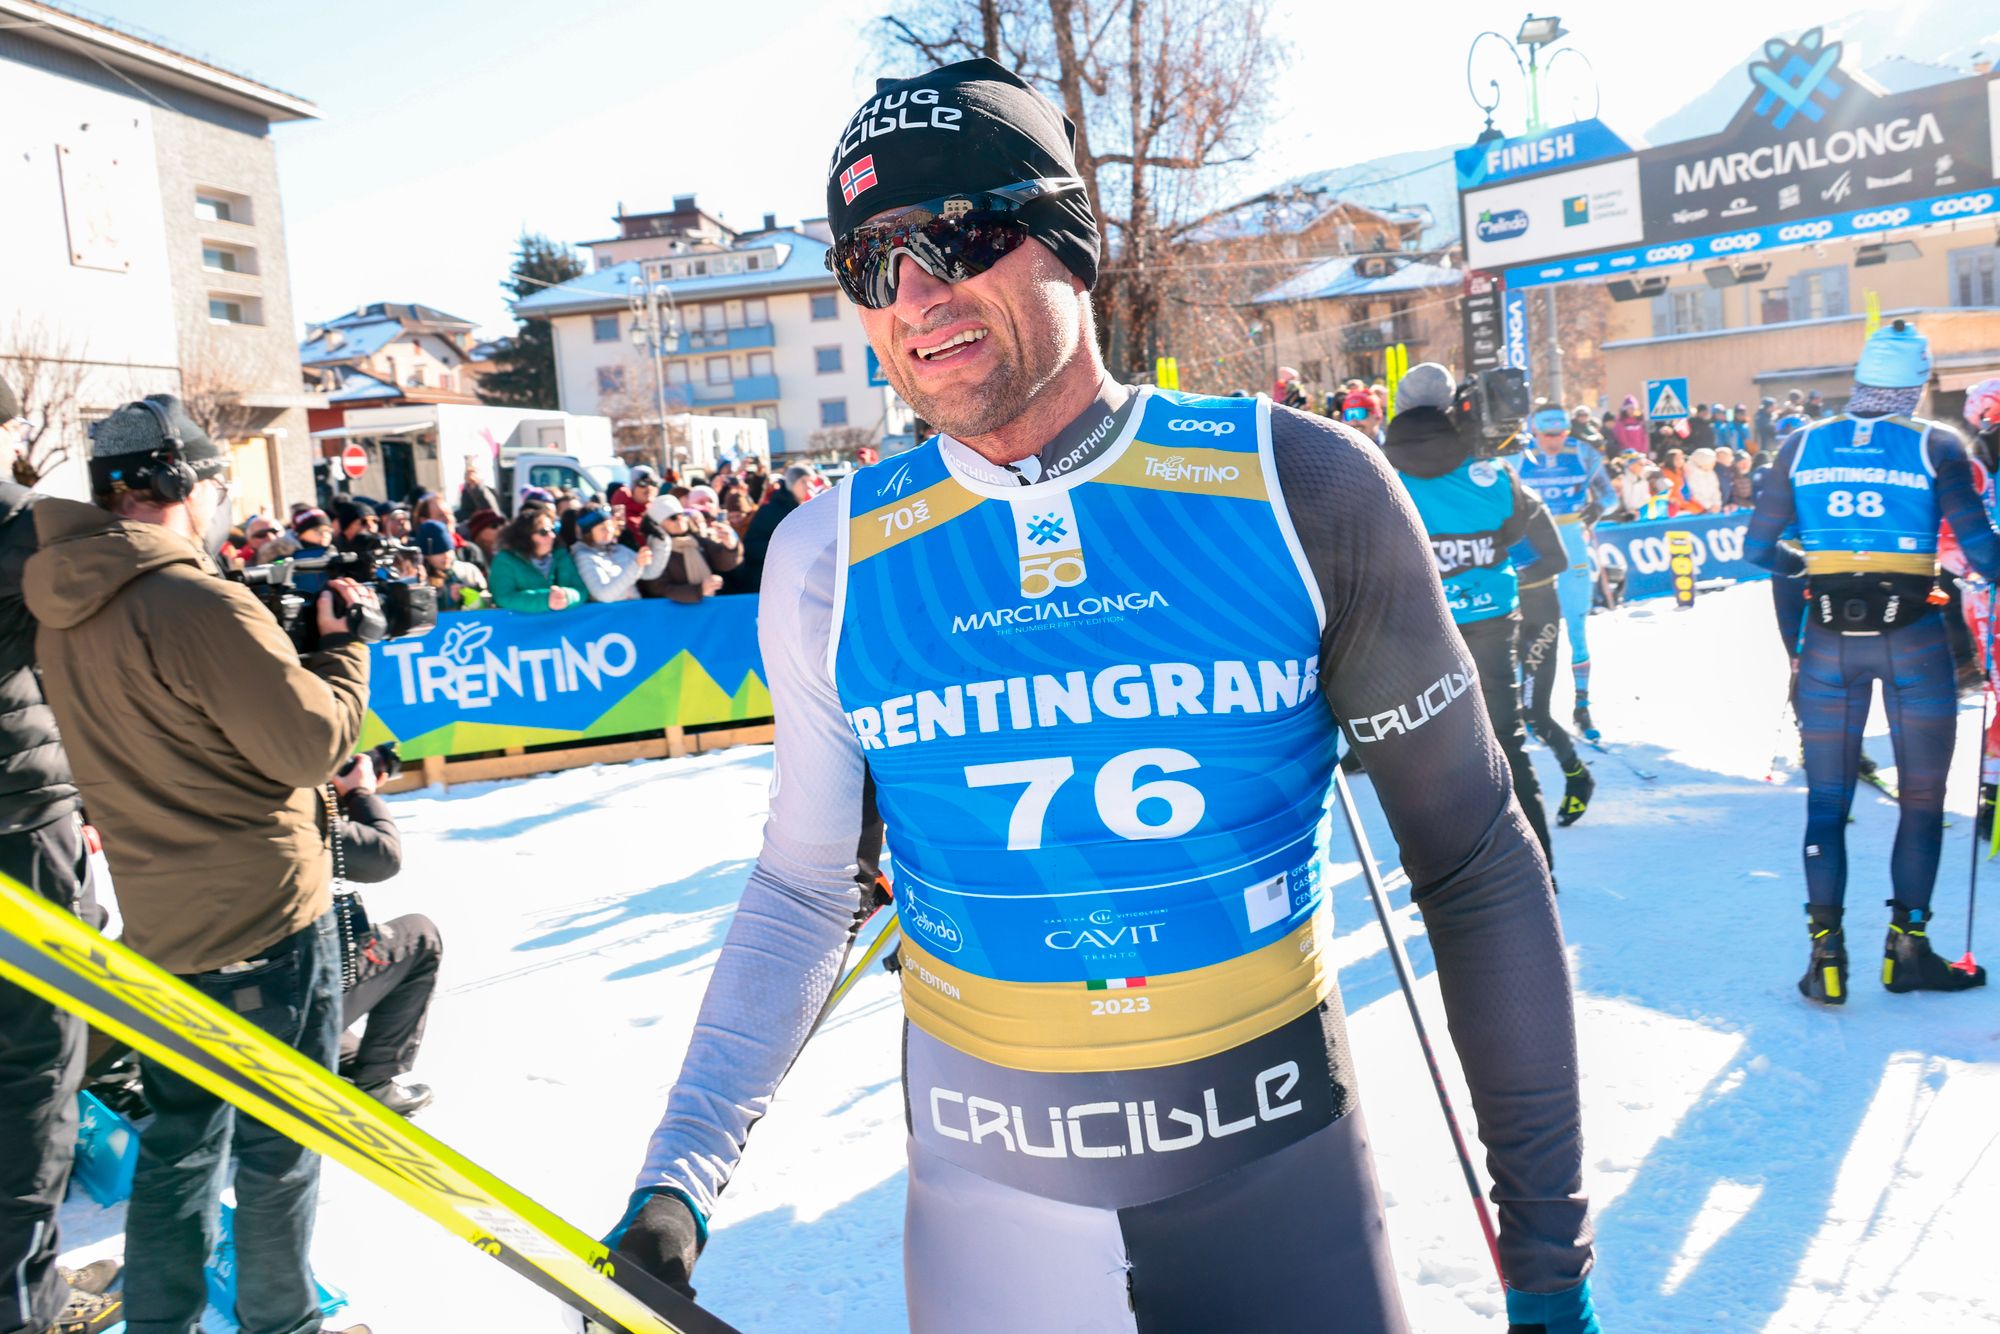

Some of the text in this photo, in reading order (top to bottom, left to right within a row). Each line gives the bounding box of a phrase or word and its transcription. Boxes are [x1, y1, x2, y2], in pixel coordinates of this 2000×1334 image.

[1486, 133, 1576, 174] FINISH
[1673, 112, 1944, 195] MARCIALONGA
[1645, 243, 1694, 262] coop
[1709, 232, 1761, 252] coop
[1778, 220, 1833, 241] coop
[1852, 207, 1911, 229] coop
[1931, 193, 1994, 216] coop
[1508, 300, 1527, 369] ONGA
[1167, 419, 1236, 437] coop
[1046, 415, 1115, 480] NORTHUG
[1145, 456, 1240, 484] TRENTINO
[1795, 467, 1930, 490] TRENTINGRANA
[878, 507, 914, 538] 70
[1826, 490, 1885, 518] 88
[1020, 556, 1087, 599] 50
[951, 590, 1170, 634] MARCIALONGA
[996, 615, 1124, 637] THE NUMBER FIFTY EDITION
[382, 632, 637, 710] TRENTINO
[844, 654, 1320, 750] RENTINGRANA
[963, 747, 1206, 850] 76
[1044, 922, 1167, 950] CAVIT
[1083, 951, 1137, 961] TRENTO
[919, 967, 960, 1000] EDITION
[1090, 996, 1151, 1016] 2023
